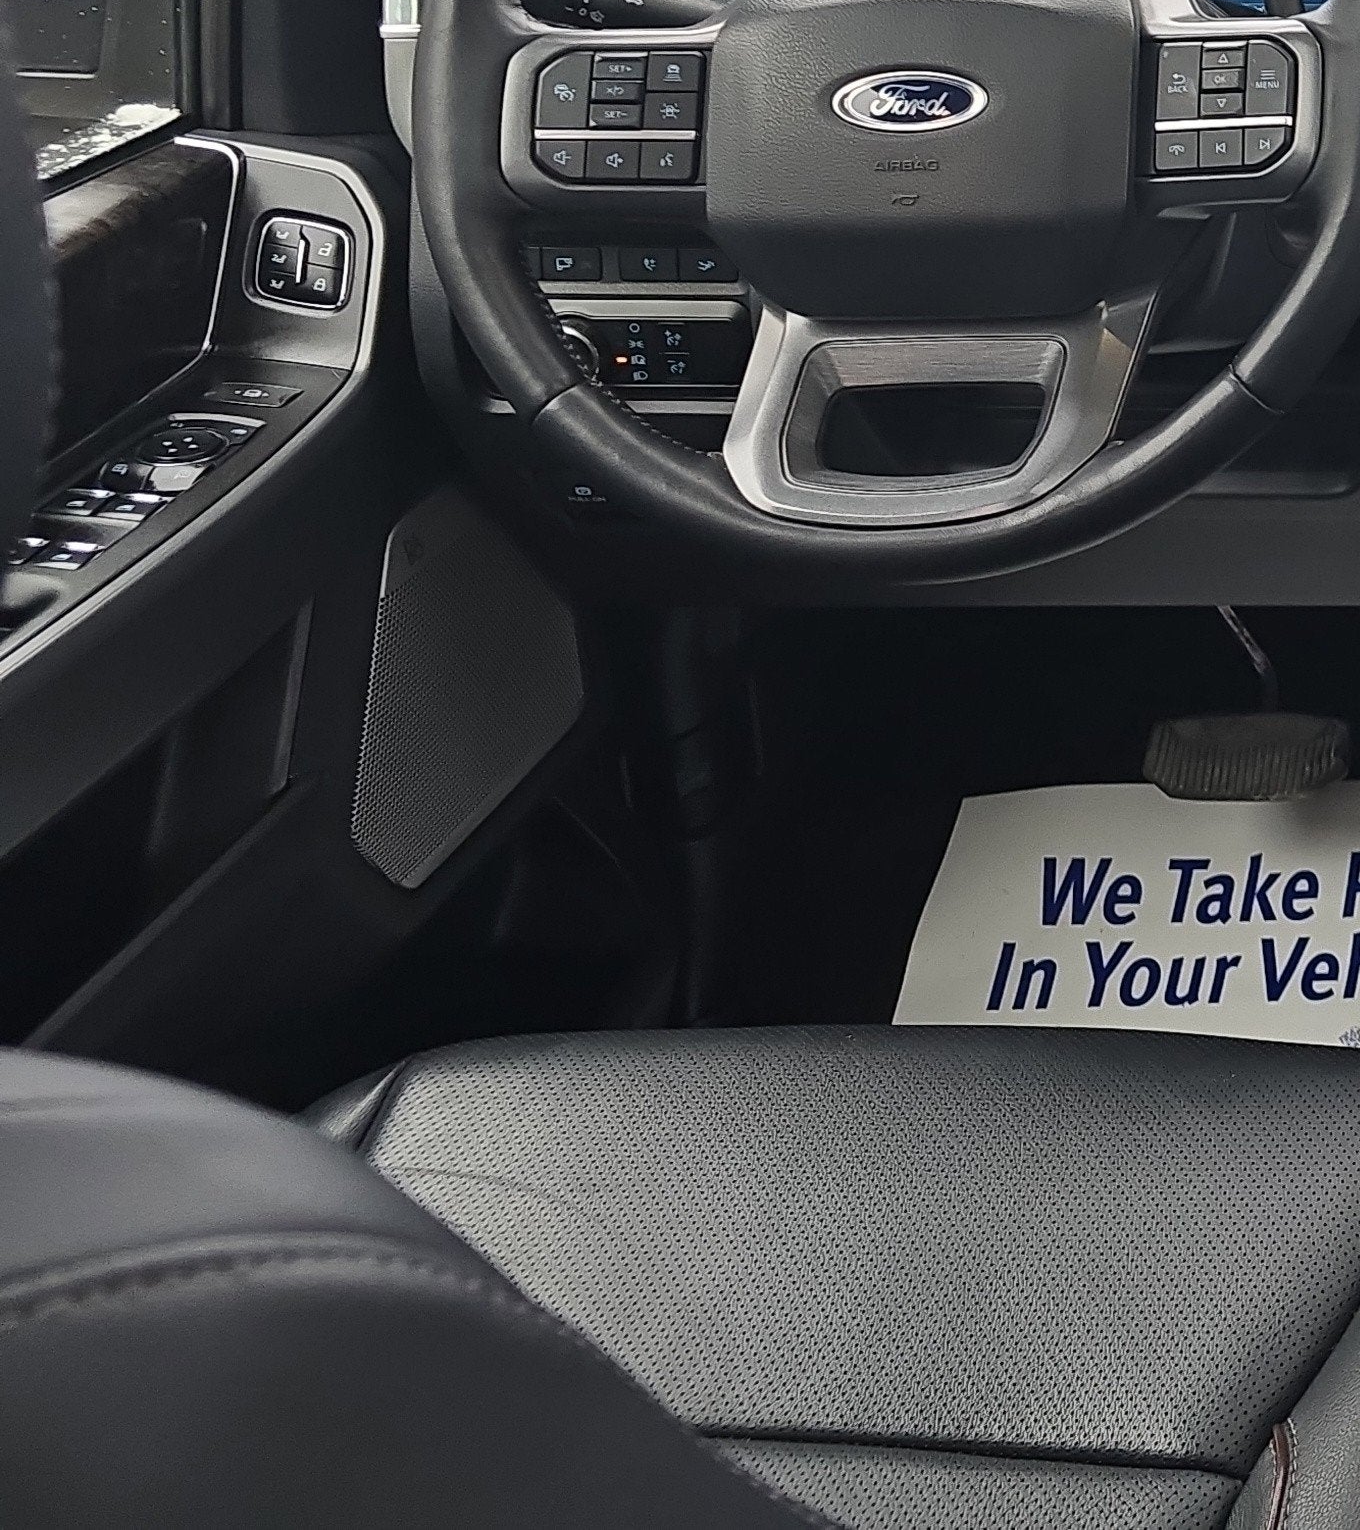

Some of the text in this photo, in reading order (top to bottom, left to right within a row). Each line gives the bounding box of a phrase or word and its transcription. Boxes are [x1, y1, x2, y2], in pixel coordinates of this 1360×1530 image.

[1214, 75, 1227, 84] OK
[1255, 80, 1280, 90] MENU
[1167, 84, 1189, 94] BACK
[869, 84, 952, 117] Ford
[874, 159, 940, 172] AIRBAG
[1041, 857, 1143, 927] We
[1168, 852, 1320, 924] Take
[986, 941, 1058, 1011] In
[1084, 939, 1241, 1008] Your
